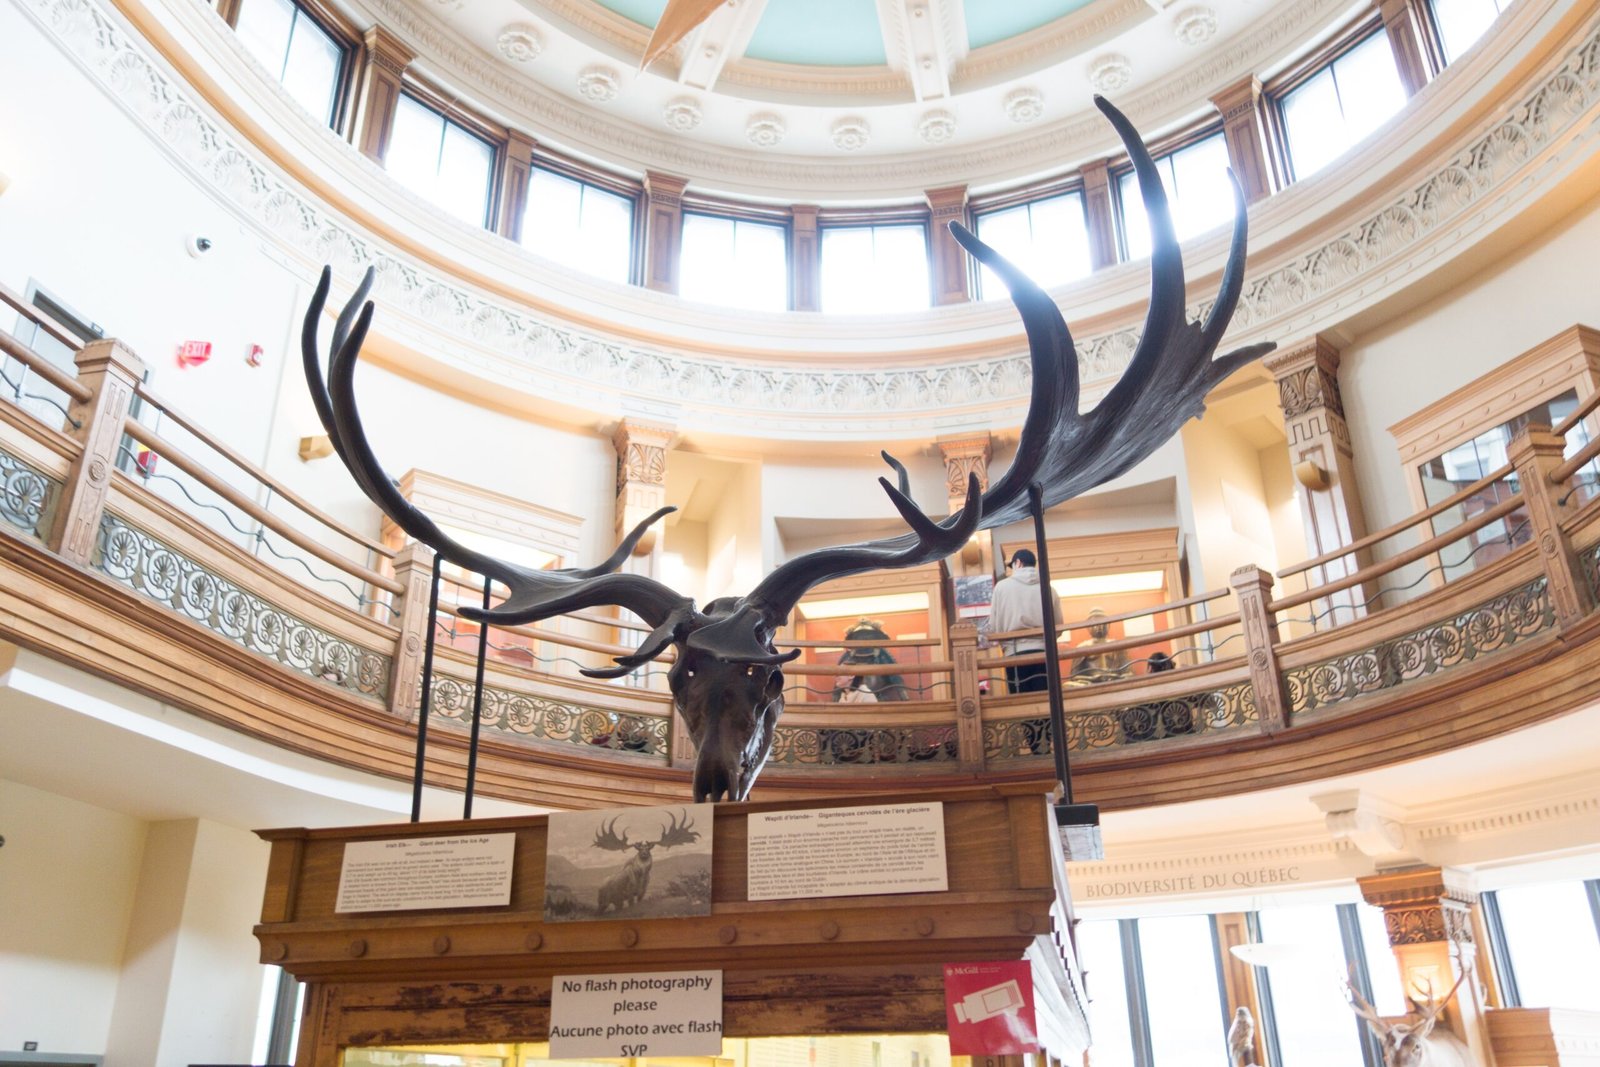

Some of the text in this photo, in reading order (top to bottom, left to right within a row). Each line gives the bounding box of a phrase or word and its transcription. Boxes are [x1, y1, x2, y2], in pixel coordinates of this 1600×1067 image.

[1086, 866, 1300, 898] BIODIVERSITÉ DU QUÉBEC
[954, 966, 979, 976] McGill
[562, 976, 713, 993] No flash photography
[613, 1000, 658, 1015] please
[550, 1020, 722, 1039] Aucune photo avec flash
[620, 1044, 648, 1057] SVP
